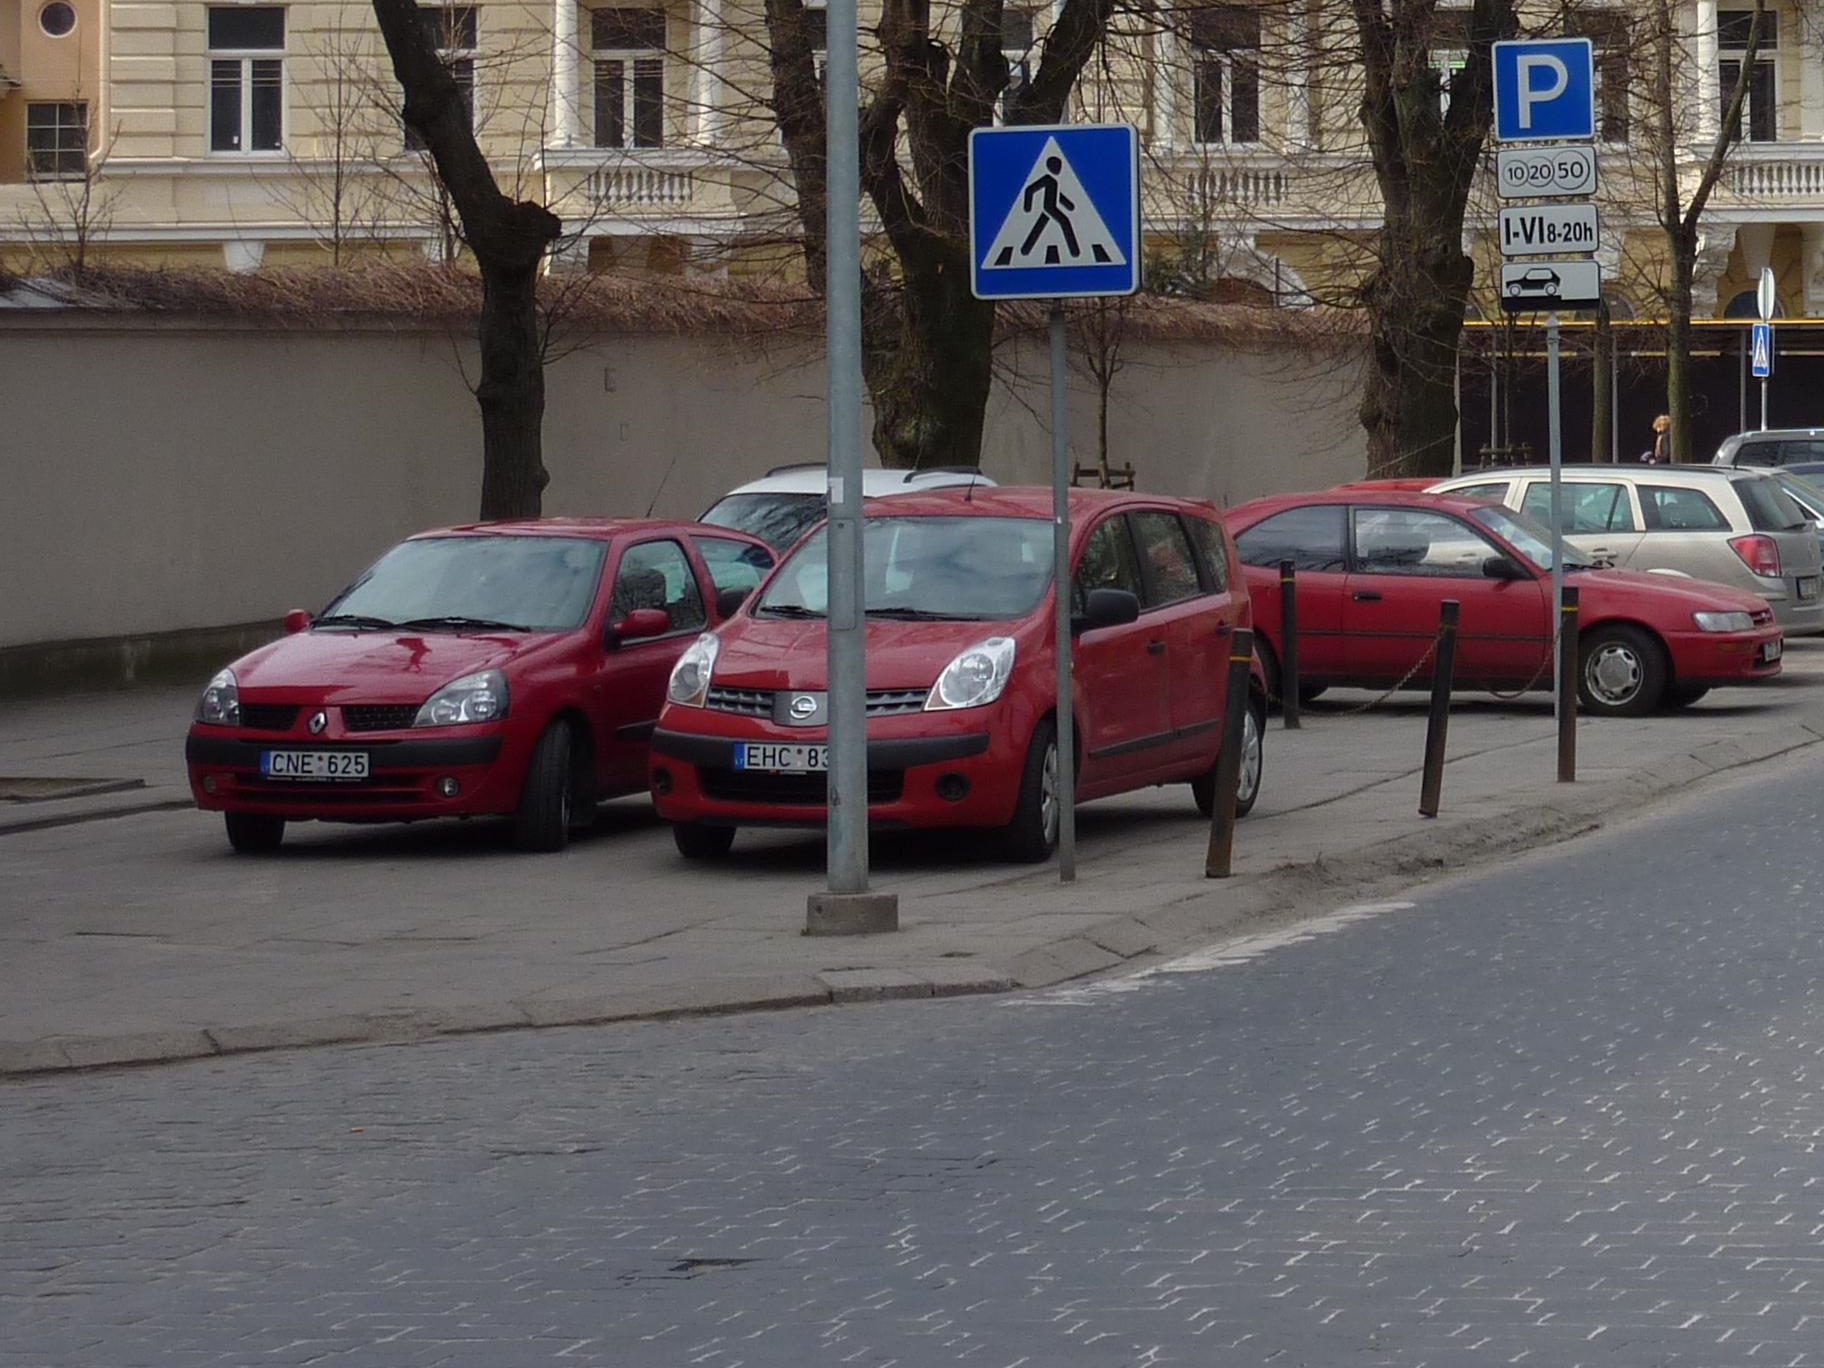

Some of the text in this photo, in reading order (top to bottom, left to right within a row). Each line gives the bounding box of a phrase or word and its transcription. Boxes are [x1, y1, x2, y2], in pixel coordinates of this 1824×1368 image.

[1516, 54, 1568, 129] P
[1508, 161, 1584, 180] 10 20 50
[273, 753, 314, 773] CNE
[327, 754, 366, 775] 625
[747, 746, 792, 768] EHC
[807, 747, 828, 769] 83
